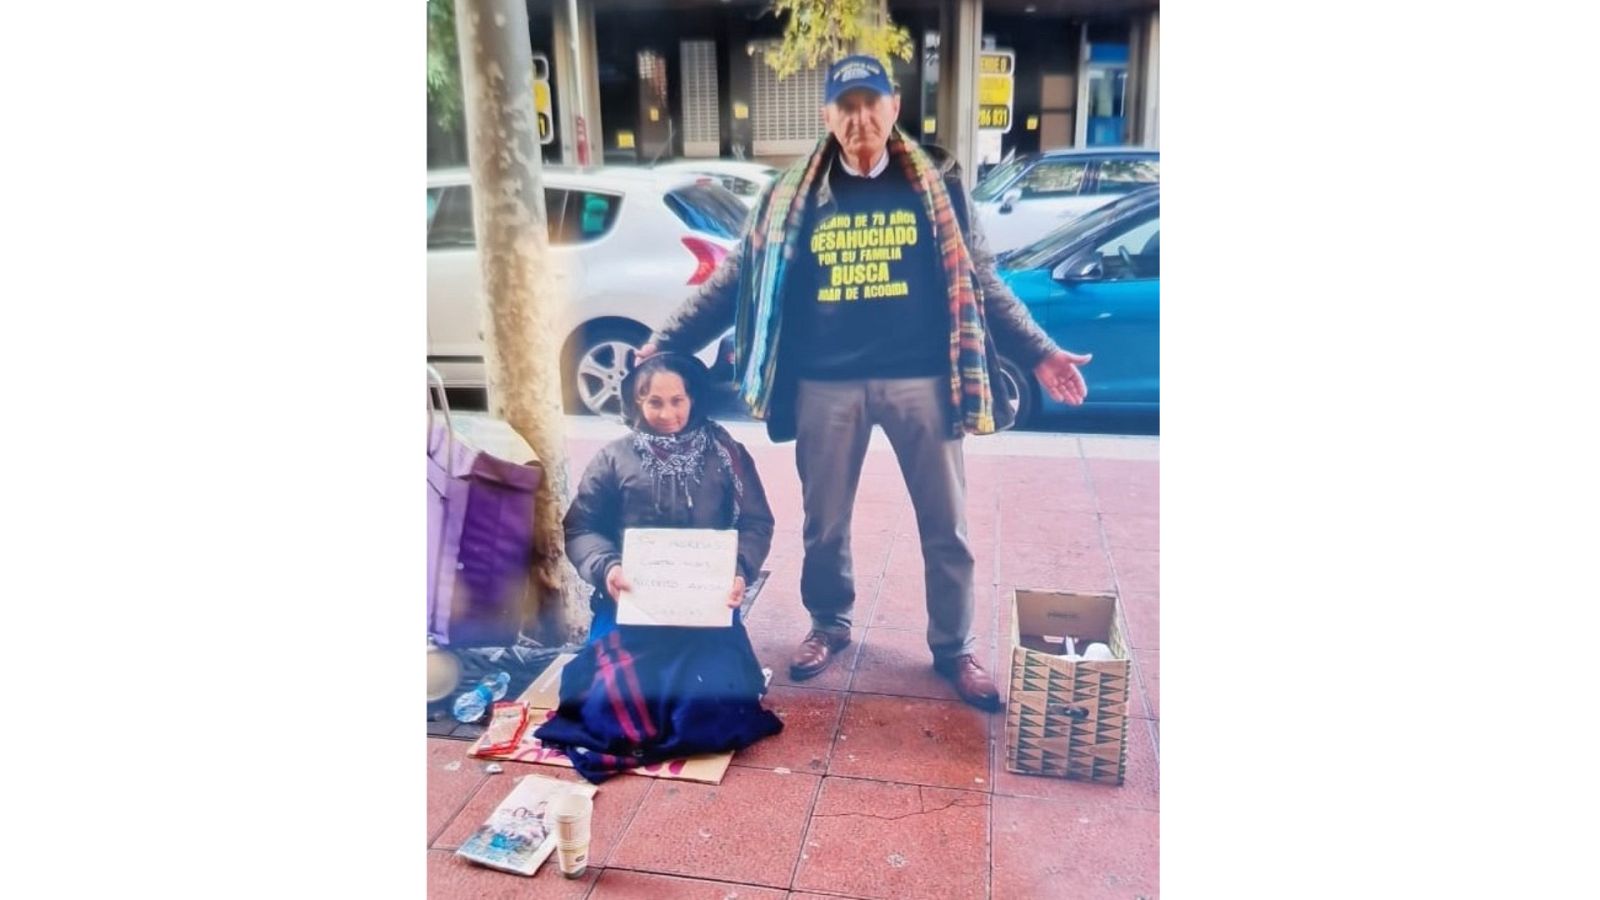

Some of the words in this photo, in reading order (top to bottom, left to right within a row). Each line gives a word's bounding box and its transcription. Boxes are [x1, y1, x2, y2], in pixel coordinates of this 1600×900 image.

[855, 214, 867, 229] DE
[890, 210, 916, 225] AÑOS
[811, 225, 917, 253] DESAHUCIADO
[819, 252, 837, 266] POR
[841, 250, 856, 263] SU
[860, 247, 902, 262] FAMILIA
[832, 262, 889, 286] BUSCA
[845, 286, 859, 300] DE
[864, 281, 908, 298] ACOGIDA
